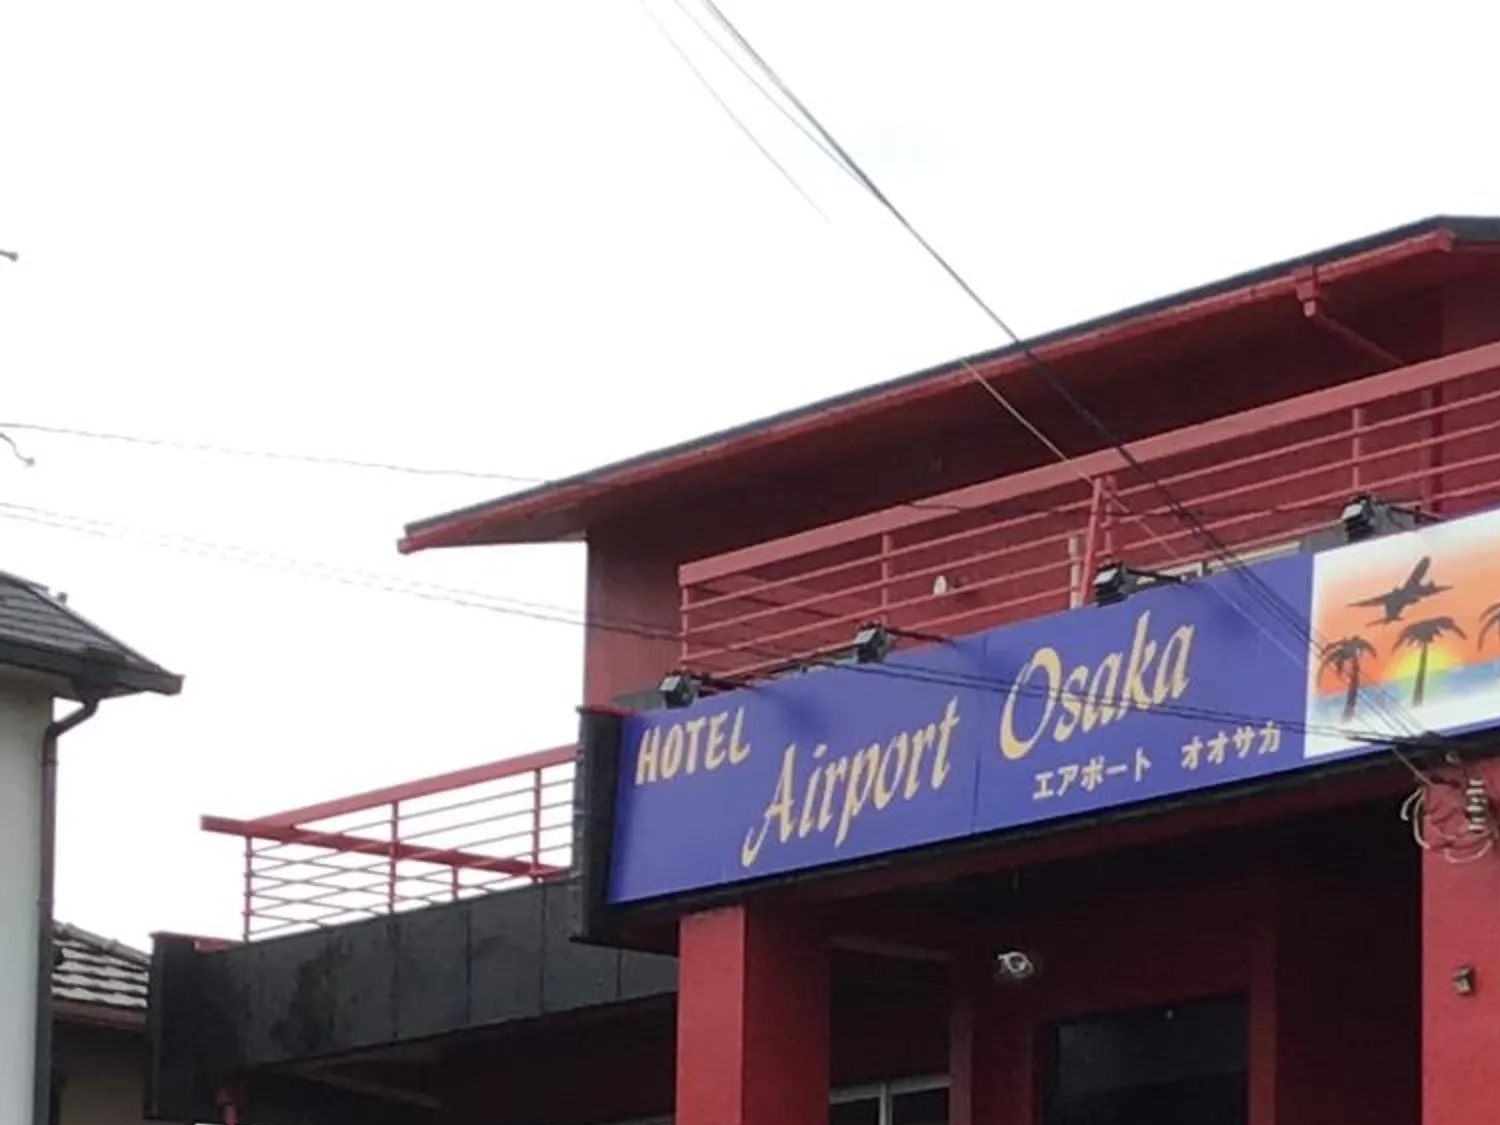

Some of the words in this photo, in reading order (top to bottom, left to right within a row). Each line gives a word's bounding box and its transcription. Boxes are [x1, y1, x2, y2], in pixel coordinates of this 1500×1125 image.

[635, 707, 750, 785] HOTEL
[741, 696, 960, 867] Airport
[1000, 610, 1195, 760] Osaka
[1181, 720, 1281, 770] オオサカ
